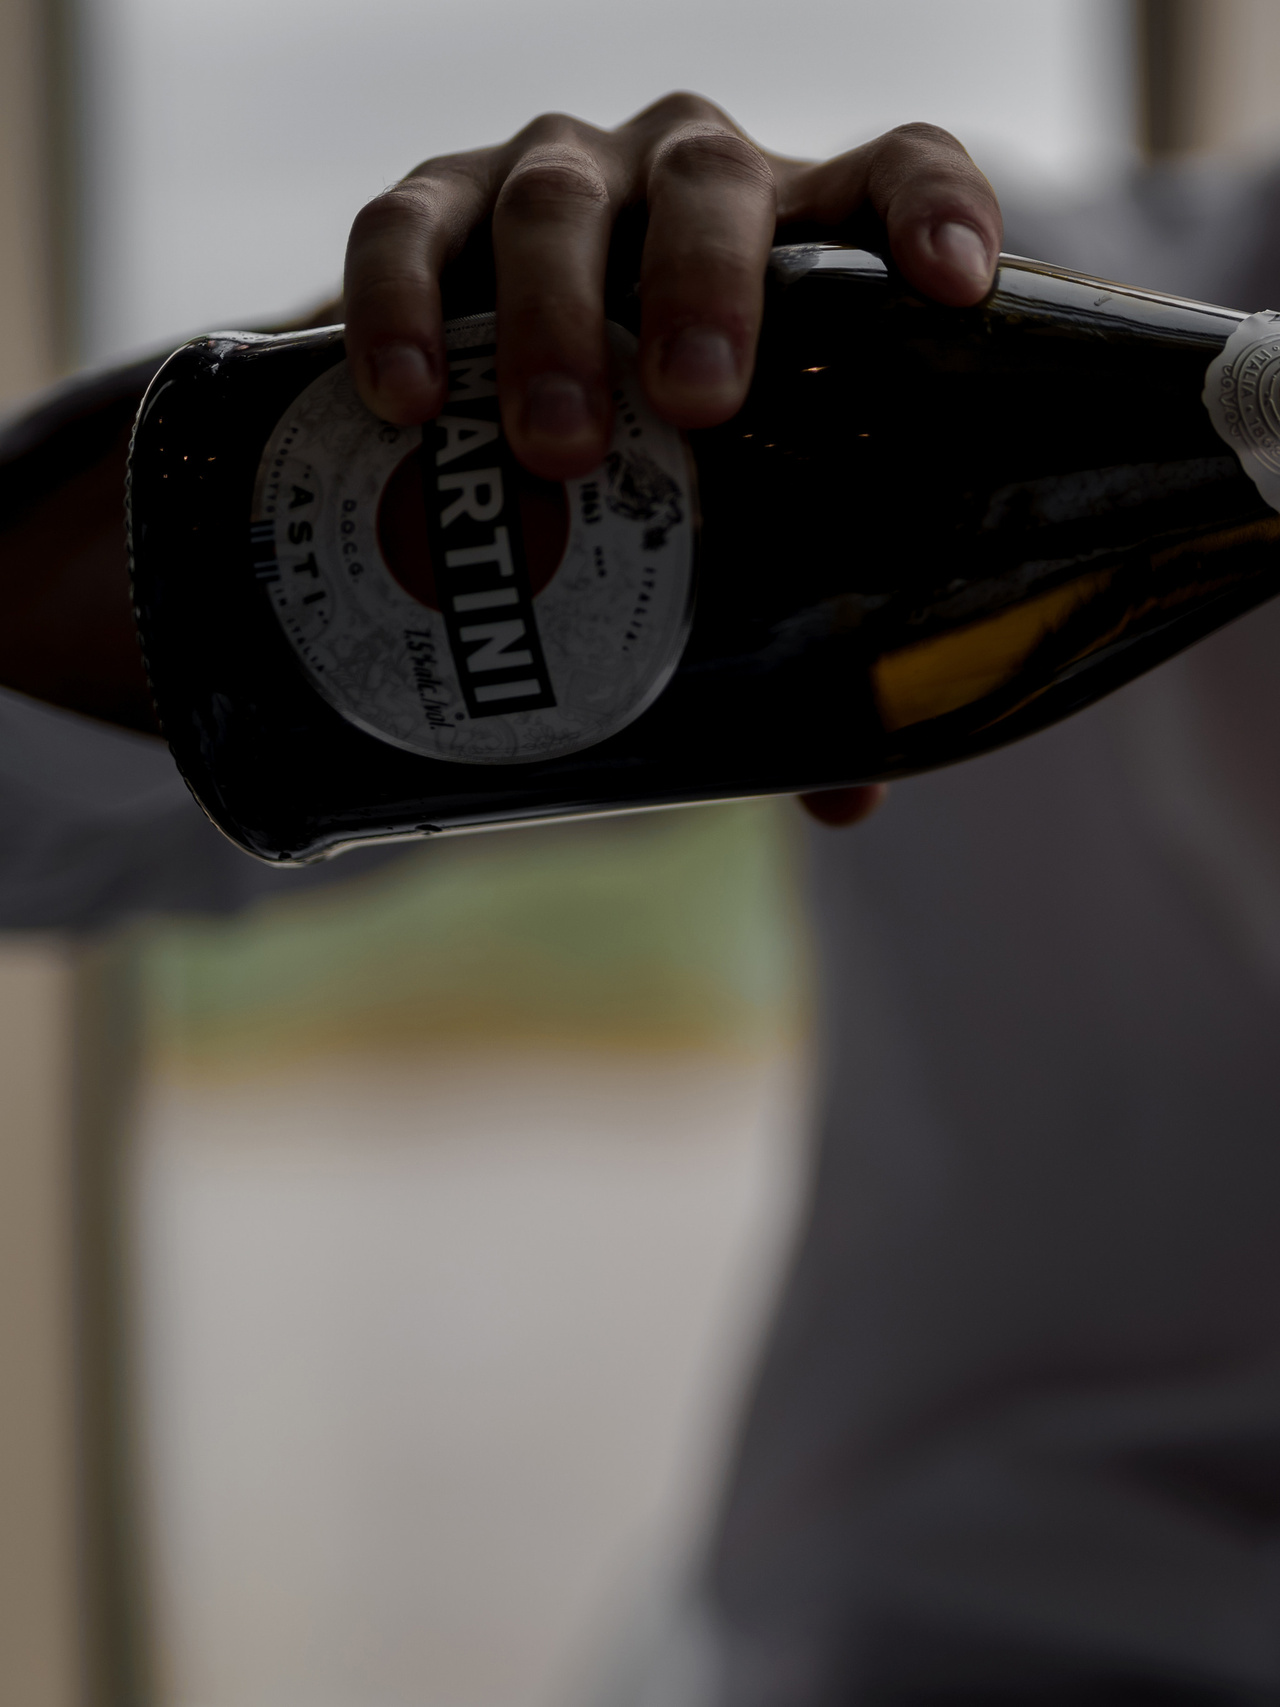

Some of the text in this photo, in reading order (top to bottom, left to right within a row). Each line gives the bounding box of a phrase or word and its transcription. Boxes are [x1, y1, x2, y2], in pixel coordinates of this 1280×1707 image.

[1239, 348, 1272, 399] ITALIA
[287, 484, 325, 605] ASTI
[340, 498, 366, 583] D.O.C.G.
[434, 354, 543, 703] MARTINI
